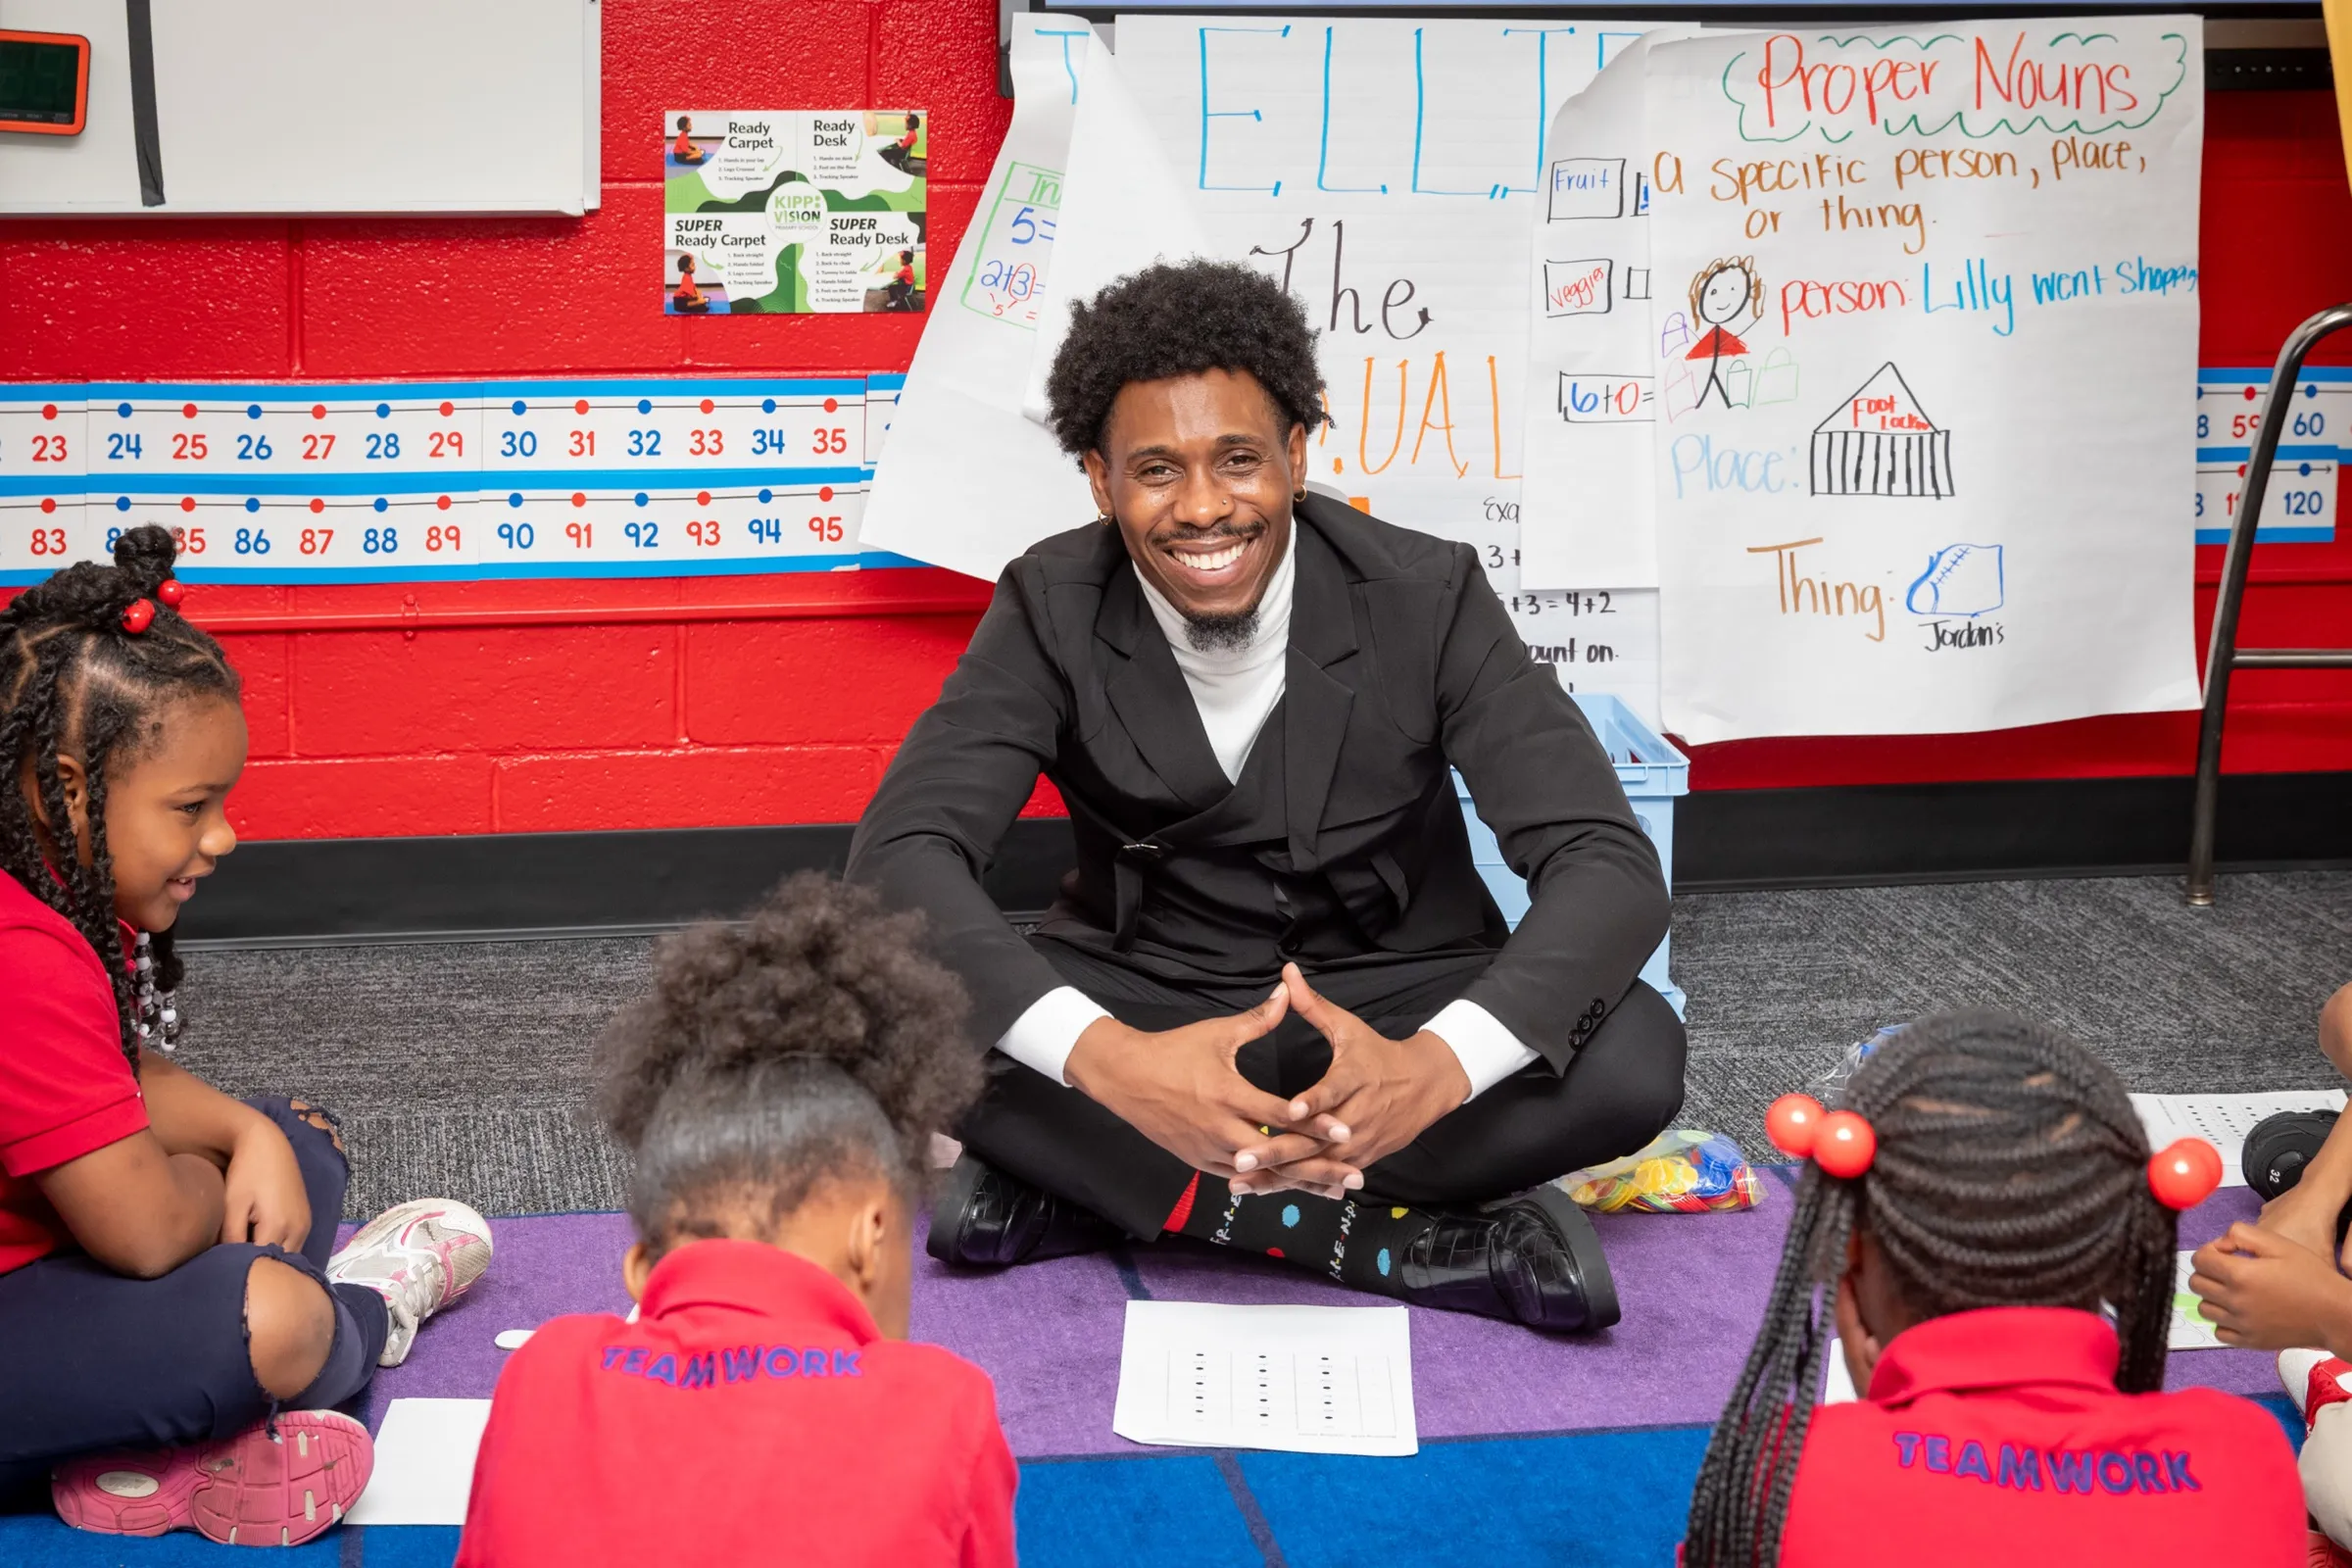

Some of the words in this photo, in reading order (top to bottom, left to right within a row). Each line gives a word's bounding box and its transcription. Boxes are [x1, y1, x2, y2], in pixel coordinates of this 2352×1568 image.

[1757, 34, 1940, 127] Proper
[1974, 30, 2138, 115] Nouns
[728, 122, 770, 136] Ready
[813, 120, 855, 134] Ready
[728, 136, 773, 150] Carpet
[813, 134, 847, 146] Desk
[1555, 169, 1609, 192] Fruit
[675, 220, 723, 231] SUPER
[773, 210, 821, 222] VISION
[830, 219, 877, 230] SUPER
[1744, 209, 1780, 239] or
[1823, 197, 1937, 254] thing.
[675, 234, 717, 249] Ready
[721, 234, 766, 248] Carpet
[830, 232, 872, 247] Ready
[875, 232, 909, 245] Desk
[1924, 258, 2015, 336] Lilly
[2032, 265, 2107, 306] went
[1853, 393, 1898, 428] Foot
[2196, 414, 2210, 439] 8
[2293, 412, 2325, 437] 60
[31, 435, 68, 462] 23
[107, 433, 143, 460] 24
[172, 434, 209, 461] 25
[237, 434, 272, 461] 26
[302, 434, 336, 461] 27
[366, 433, 401, 460] 28
[428, 431, 464, 458] 29
[501, 431, 538, 458] 30
[568, 431, 595, 457] 31
[627, 430, 662, 457] 32
[689, 429, 724, 456] 33
[751, 428, 786, 455] 34
[812, 427, 847, 454] 35
[2283, 491, 2324, 515] 120
[30, 529, 68, 556] 83
[105, 527, 131, 555] 8
[234, 529, 271, 555] 86
[299, 529, 334, 555] 87
[363, 528, 399, 555] 88
[425, 525, 462, 552] 89
[497, 522, 534, 550] 90
[565, 522, 593, 549] 91
[624, 521, 659, 548] 92
[686, 520, 721, 546] 93
[748, 518, 782, 544] 94
[808, 516, 844, 542] 95
[1528, 637, 1578, 663] ount
[2269, 1167, 2280, 1185] 32
[602, 1346, 862, 1390] TEAMWORK
[1893, 1432, 2201, 1494] TEAMWORK
